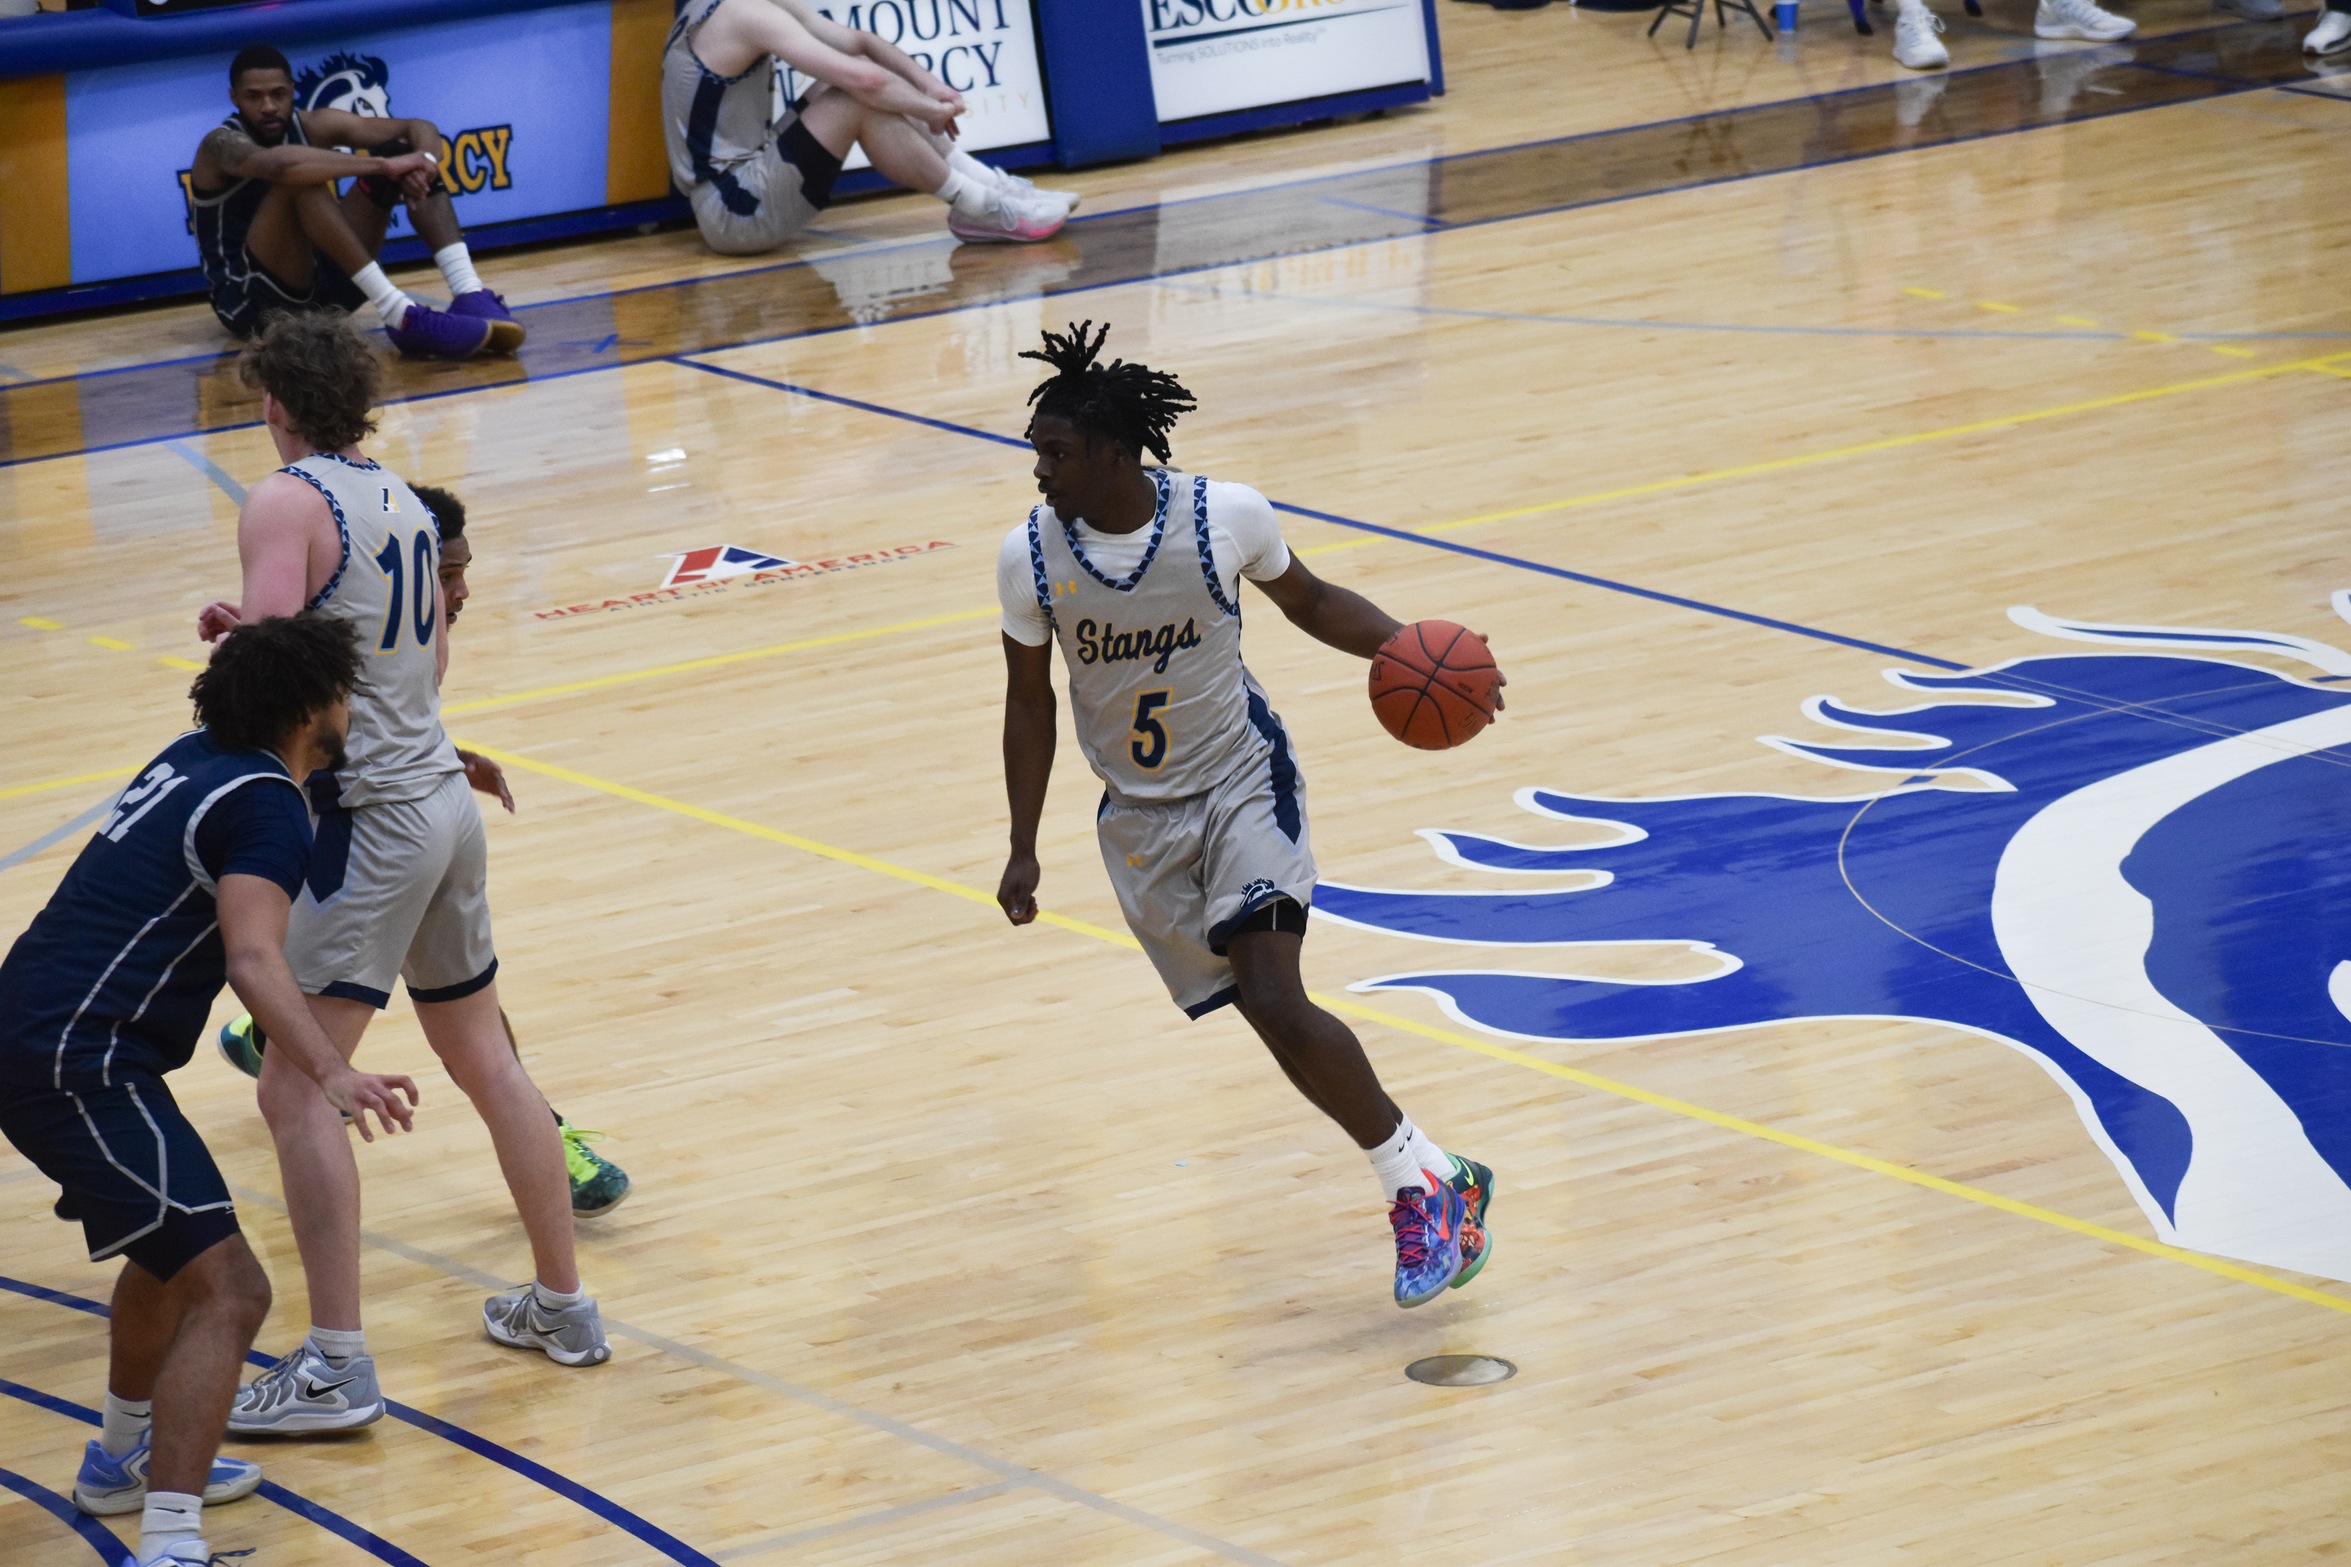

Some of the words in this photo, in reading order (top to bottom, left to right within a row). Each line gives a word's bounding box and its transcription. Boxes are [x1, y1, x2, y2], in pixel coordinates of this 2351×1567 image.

[1198, 39, 1259, 57] SOLUTIONS
[1261, 38, 1282, 47] into
[371, 525, 438, 655] 10
[534, 587, 681, 620] HEART
[696, 578, 734, 589] OF
[753, 540, 955, 582] AMERICA
[1075, 617, 1202, 674] Stangs
[1128, 687, 1173, 772] 5
